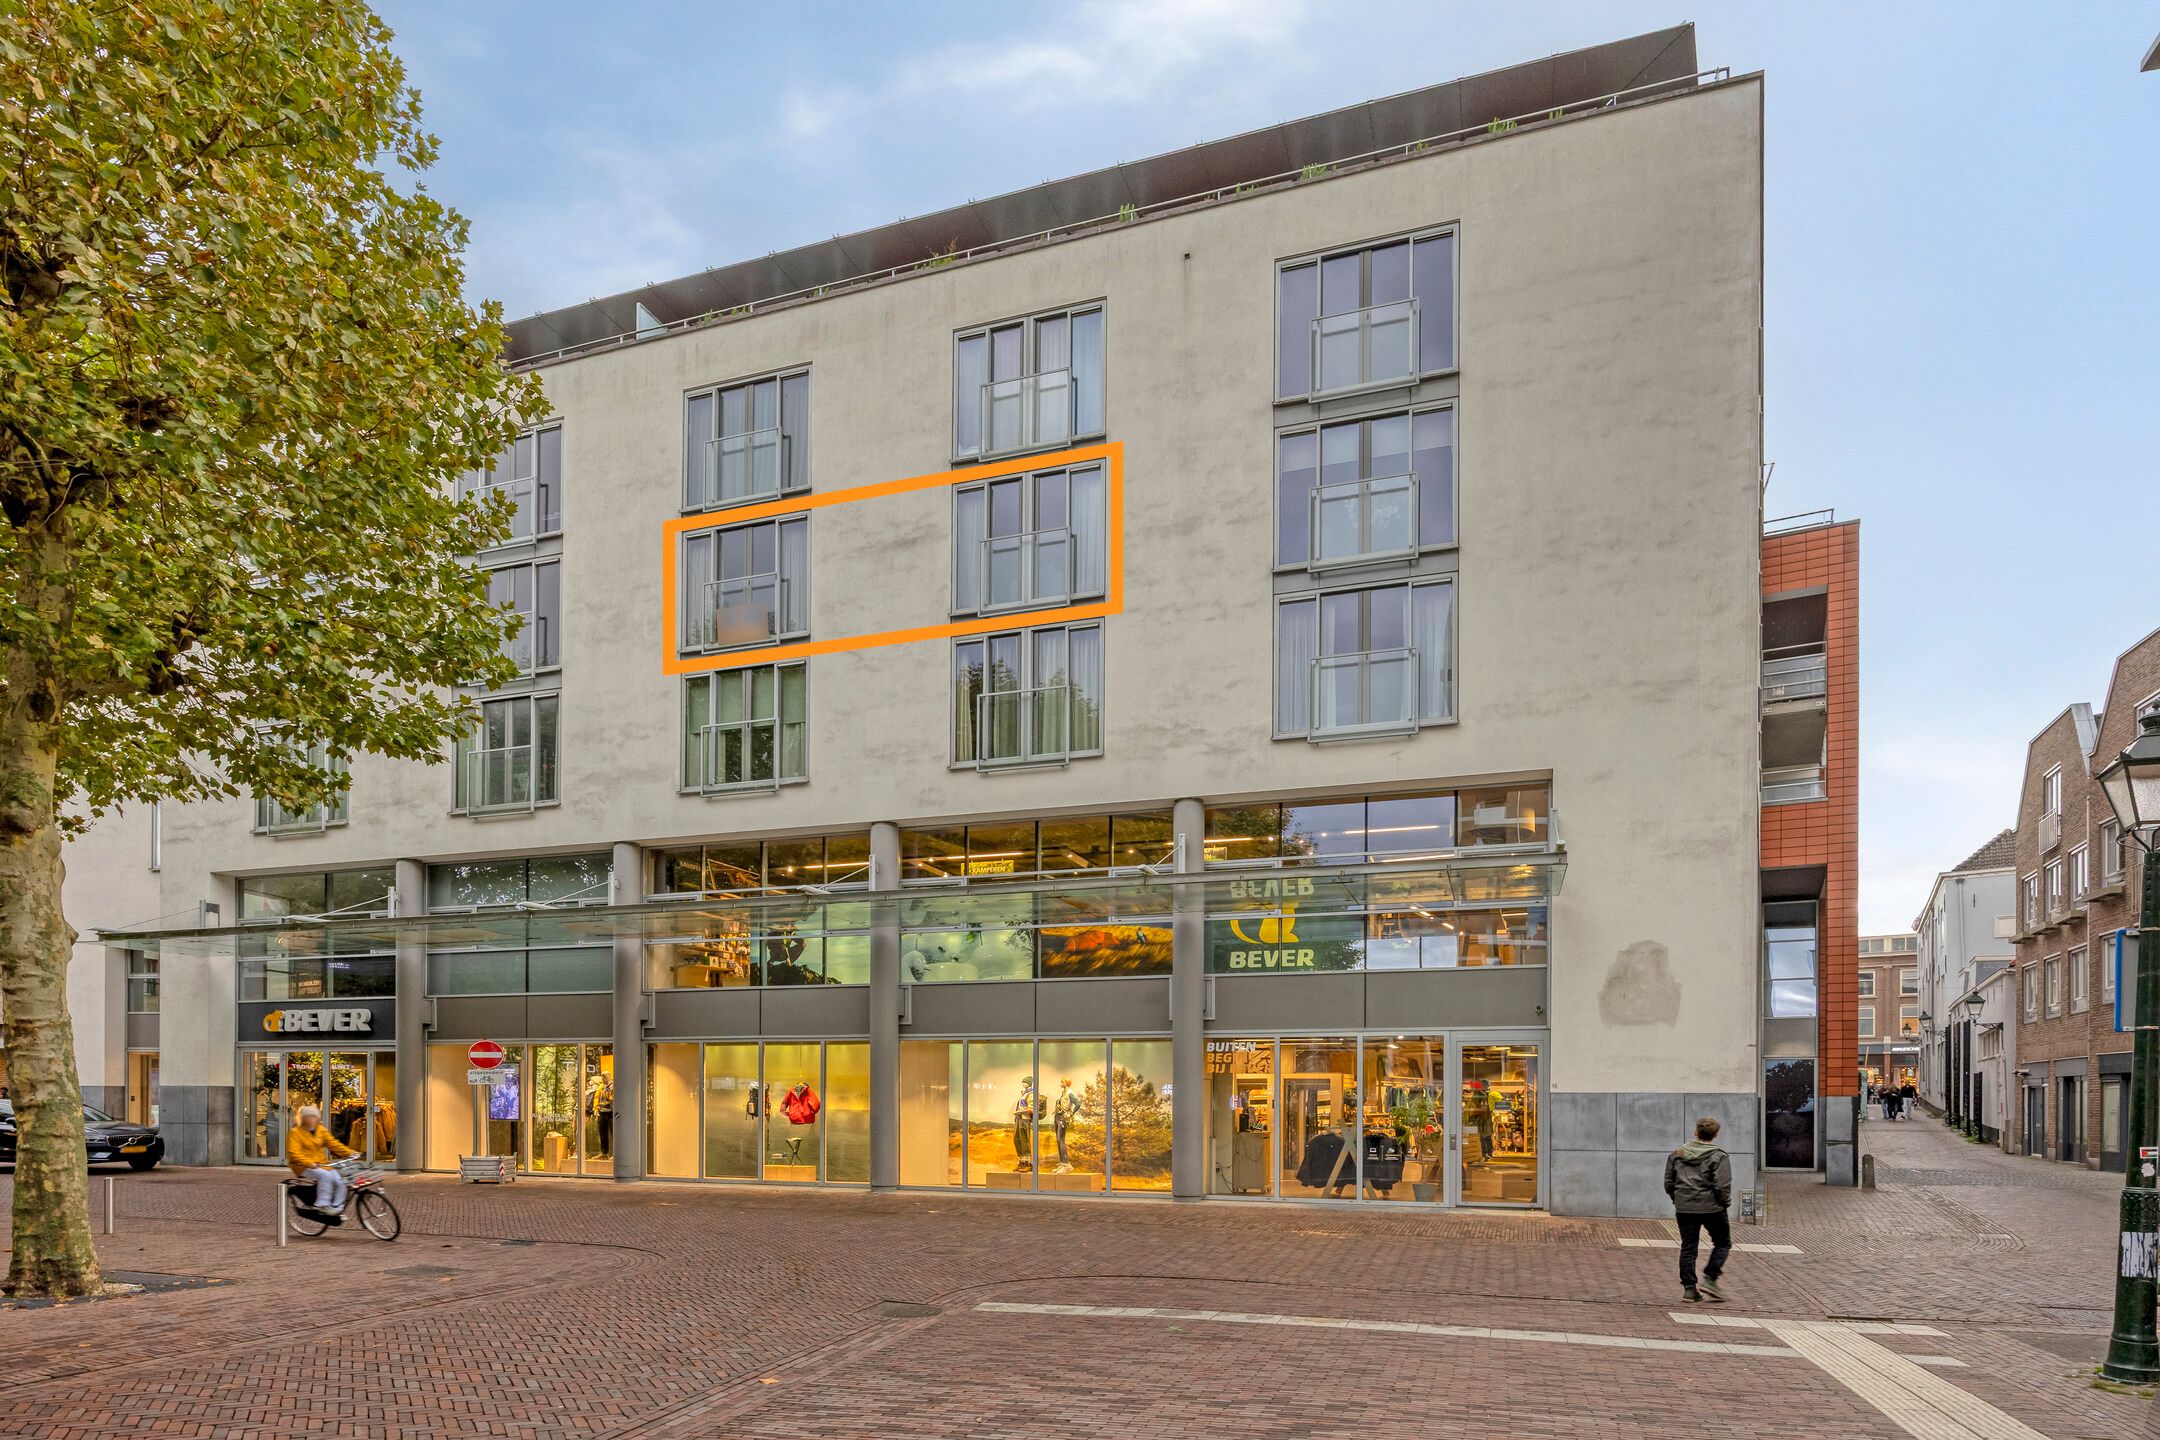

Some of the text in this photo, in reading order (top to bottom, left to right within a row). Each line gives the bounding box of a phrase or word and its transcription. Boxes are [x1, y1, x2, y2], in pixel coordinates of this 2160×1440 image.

[971, 865, 1007, 875] KAMPEREN
[1229, 949, 1315, 969] BEVER
[284, 1008, 372, 1032] BEVER
[1206, 1042, 1256, 1052] BUITEN
